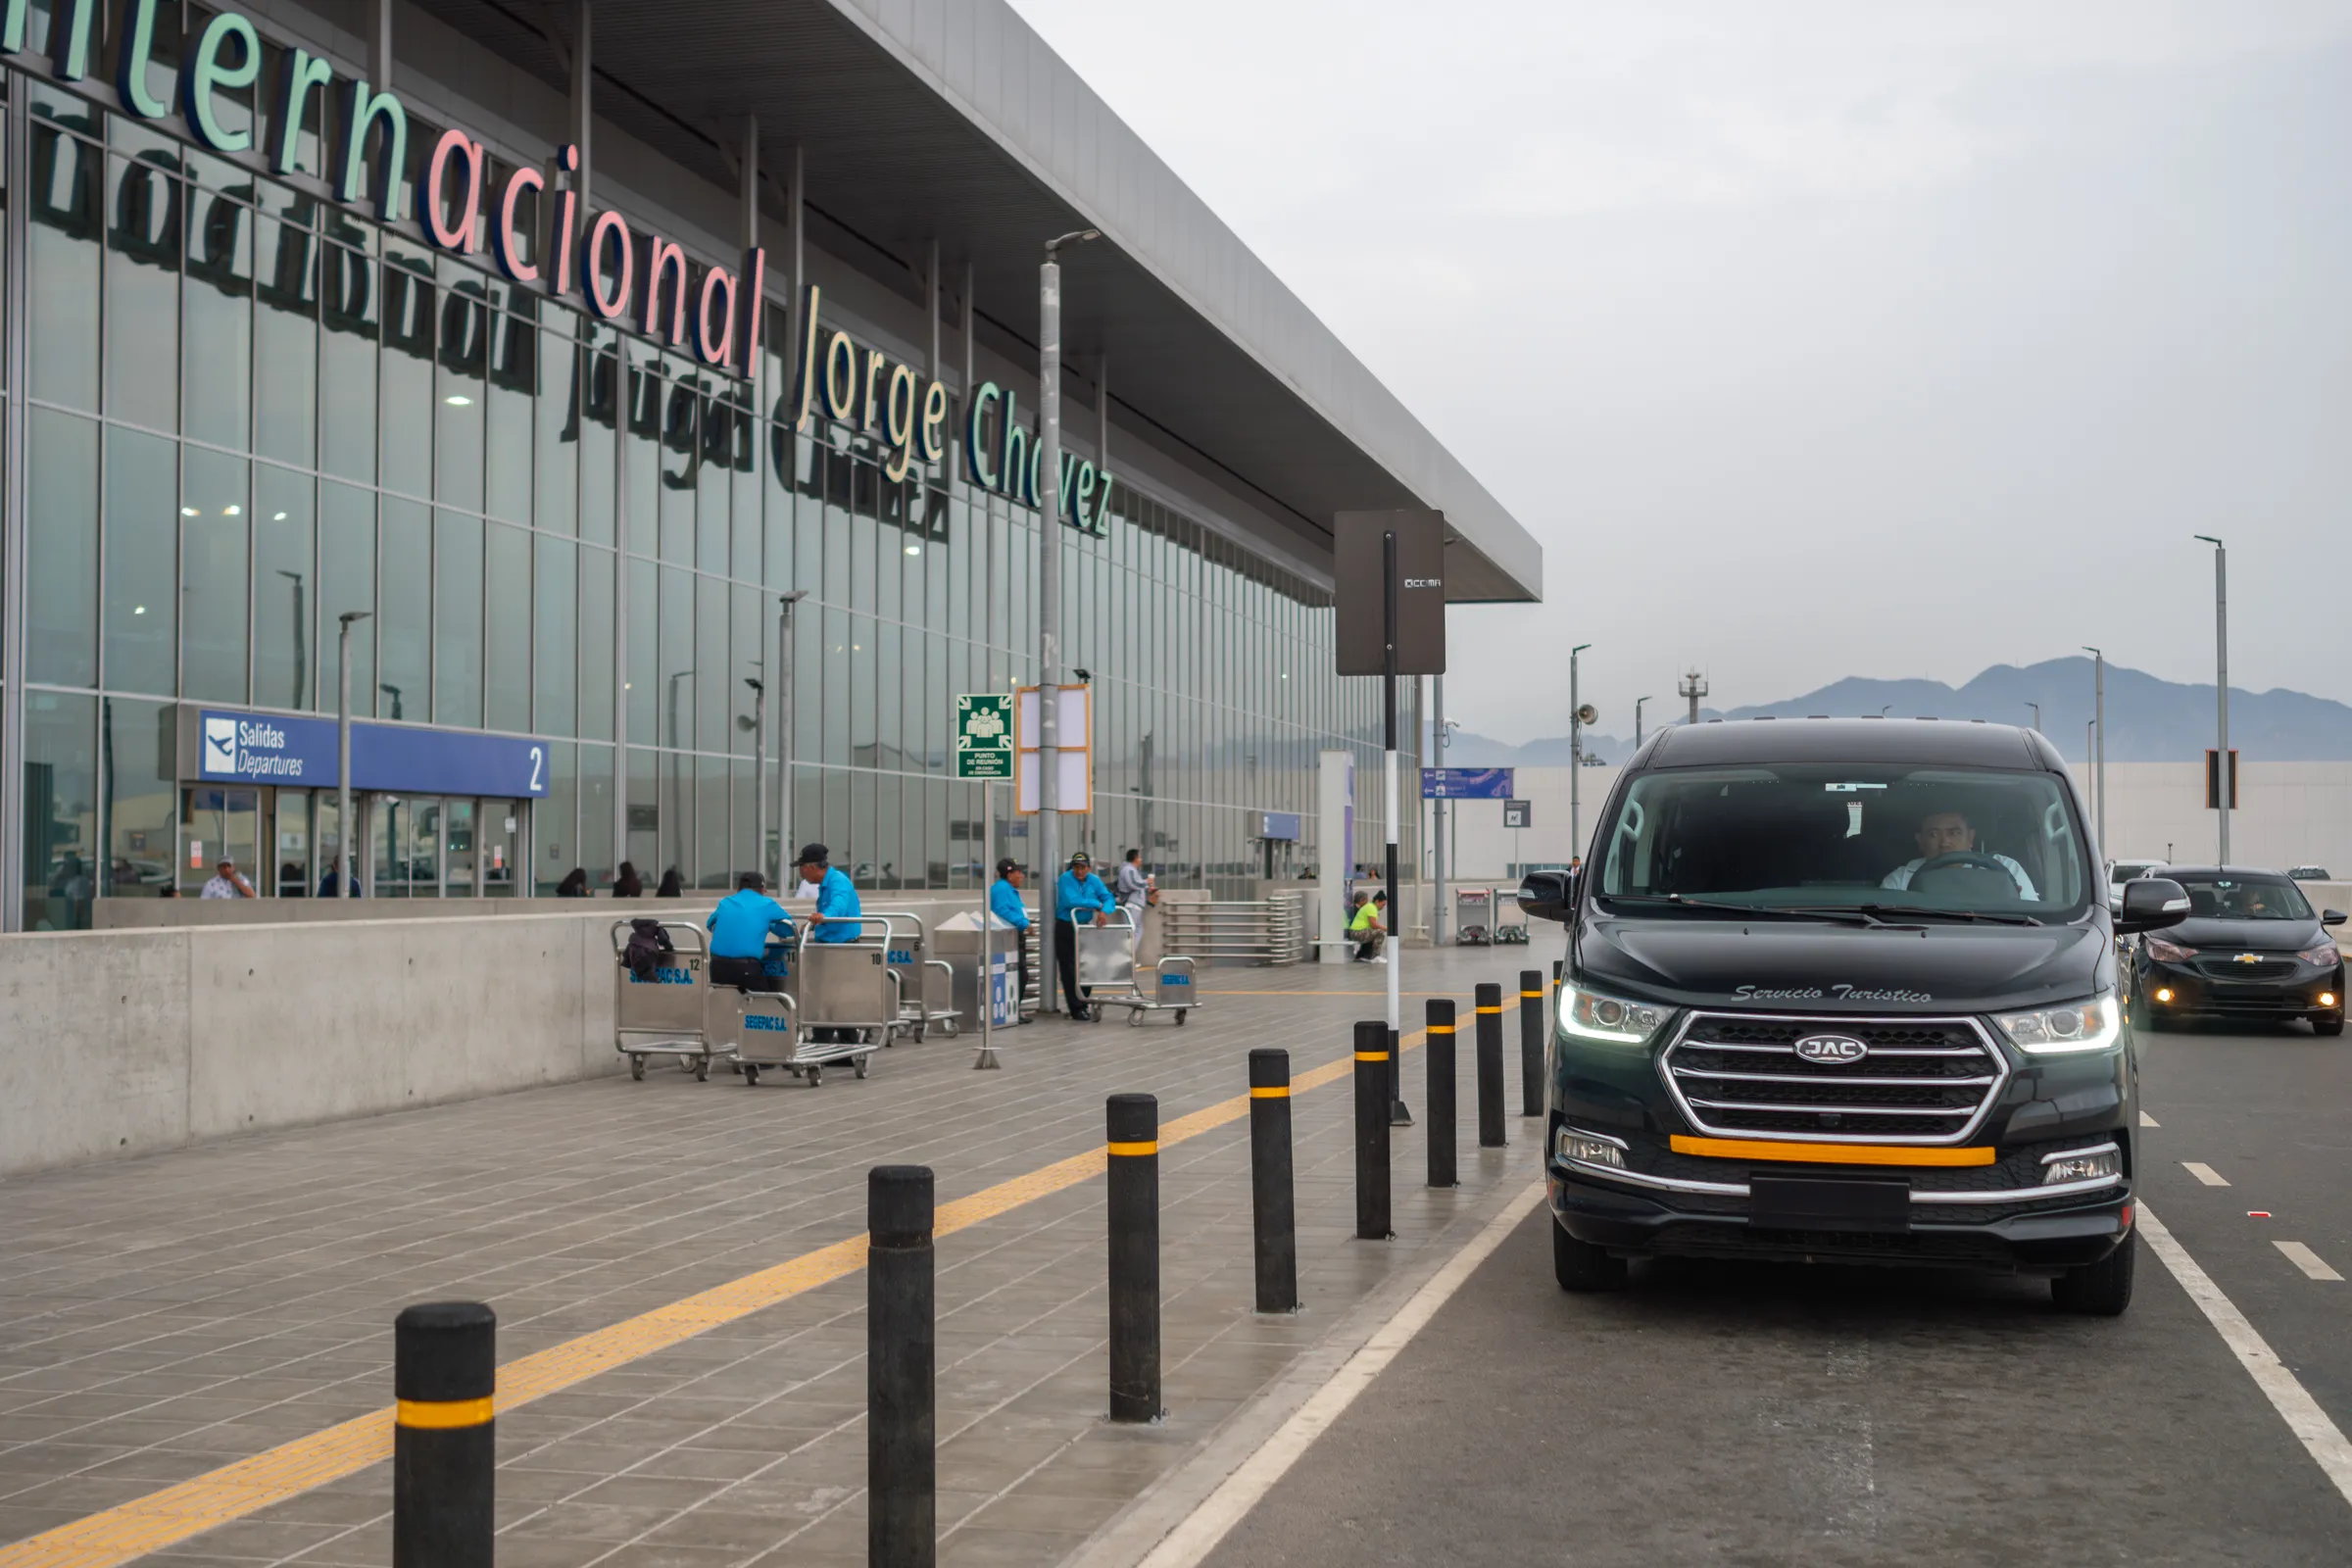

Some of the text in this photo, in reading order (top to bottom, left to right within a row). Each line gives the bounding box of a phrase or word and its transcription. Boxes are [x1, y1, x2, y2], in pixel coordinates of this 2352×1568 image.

[795, 284, 947, 483] Jorge
[239, 720, 285, 749] Salidas
[237, 749, 304, 779] Departures
[530, 747, 542, 791] 2
[913, 941, 920, 953] 6
[690, 958, 701, 971] 12
[787, 952, 797, 963] 11
[871, 953, 882, 965] 10
[674, 967, 694, 984] S.A.
[1731, 984, 1933, 1004] Servicio Turistico
[775, 1016, 787, 1032] S.A.
[1805, 1041, 1857, 1055] JAC
